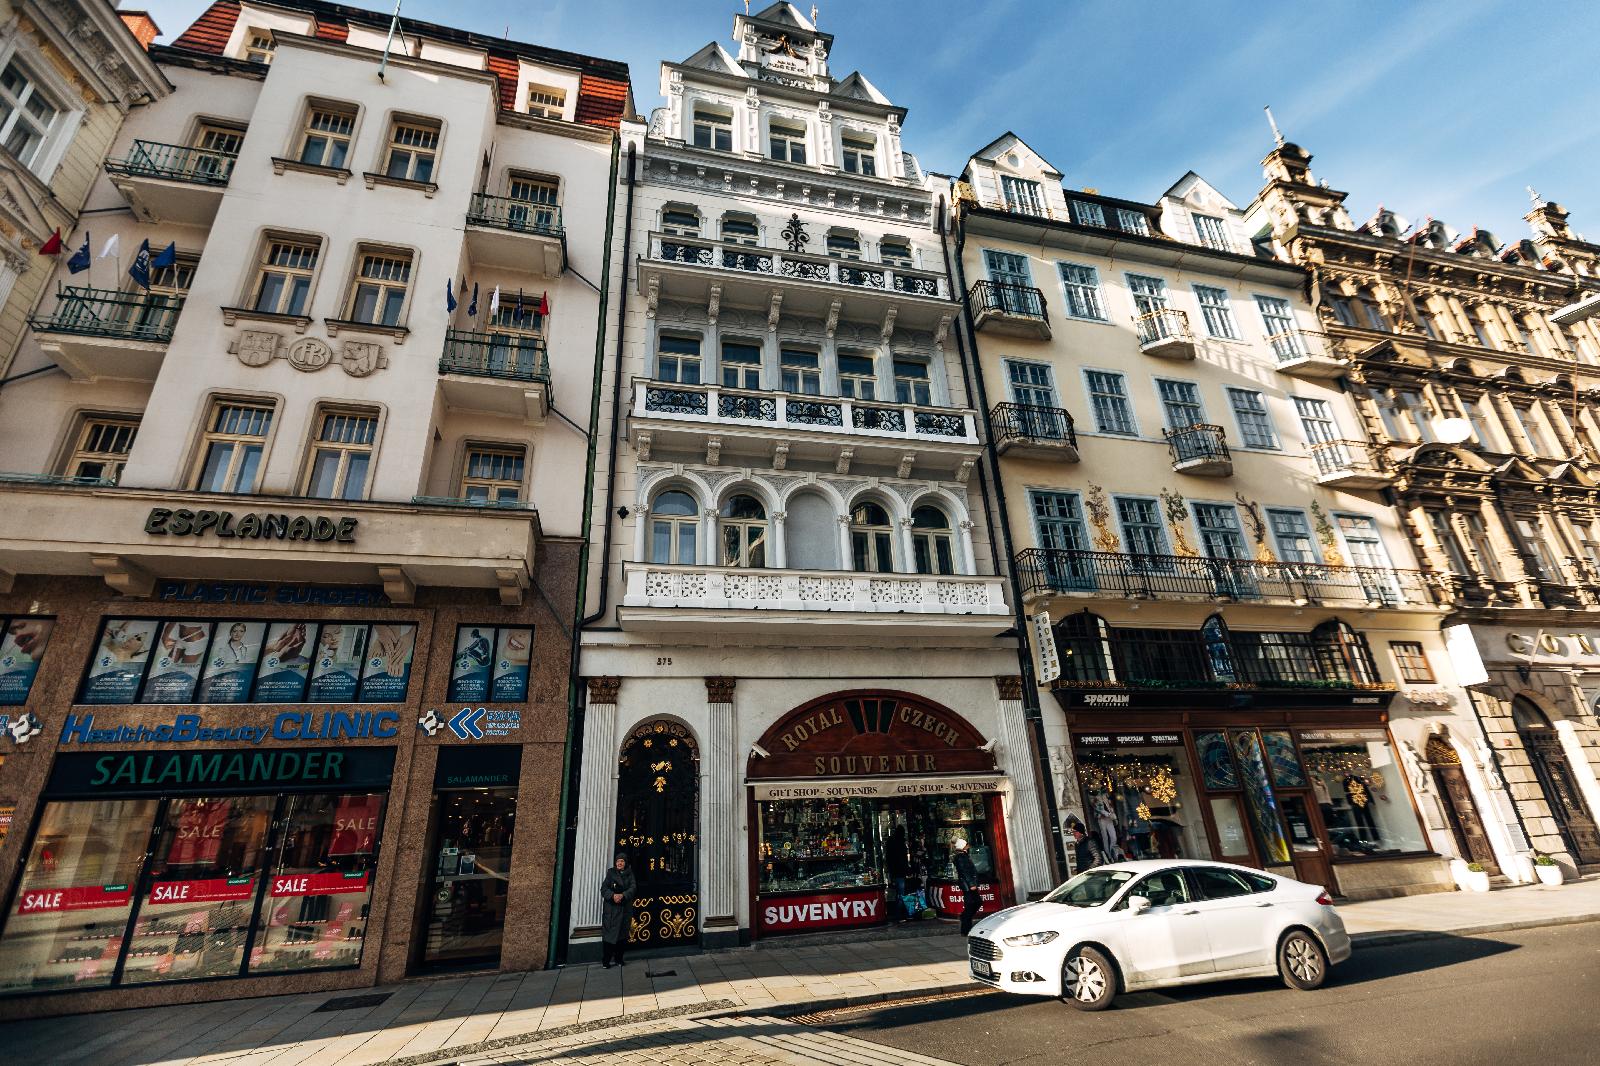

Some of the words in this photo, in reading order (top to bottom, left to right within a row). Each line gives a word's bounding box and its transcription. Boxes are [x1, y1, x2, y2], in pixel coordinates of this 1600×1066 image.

[144, 507, 359, 544] ESPLANADE
[160, 582, 268, 604] PLASTIC
[60, 713, 269, 745] Health&Beauty
[272, 711, 399, 739] CLINIC
[781, 707, 843, 751] ROYAL
[900, 706, 960, 747] CZECH
[90, 752, 345, 786] SALAMANDER
[815, 753, 937, 775] SOUVENIR
[447, 774, 509, 784] SALAMANDER
[897, 784, 918, 793] GIFT
[919, 783, 944, 793] SHOP
[950, 781, 998, 791] SOUVENIRS
[769, 788, 793, 797] GIFT
[793, 788, 819, 797] SHOP
[826, 786, 878, 796] SOUVENIRS
[178, 824, 222, 838] SALE
[335, 817, 376, 831] SALE
[153, 885, 190, 900] SALE
[275, 878, 309, 893] SALE
[23, 893, 63, 909] SALE
[764, 898, 879, 925] SUVENÝRY
